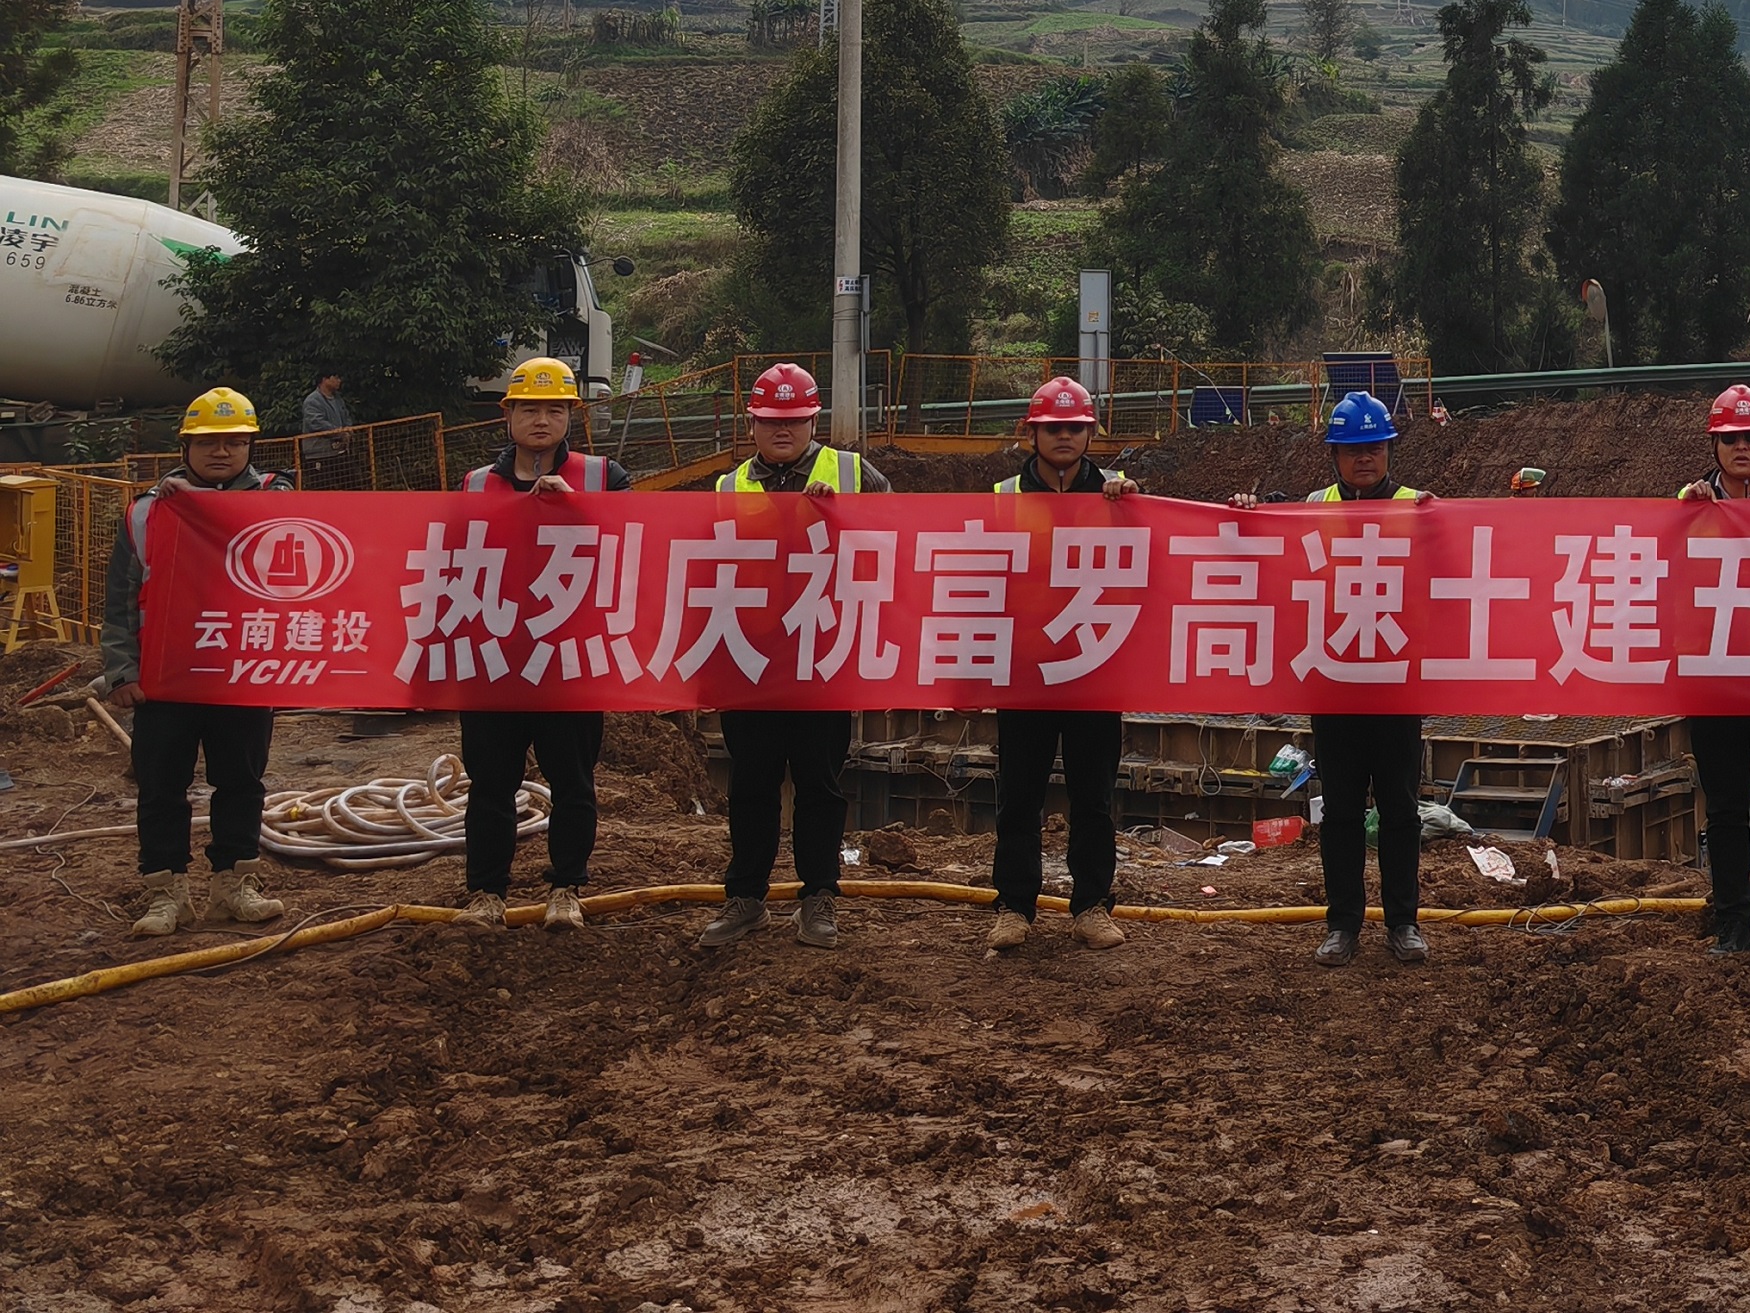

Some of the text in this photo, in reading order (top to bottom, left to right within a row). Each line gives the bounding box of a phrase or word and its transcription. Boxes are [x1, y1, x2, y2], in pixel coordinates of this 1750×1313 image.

[6, 251, 46, 270] 659
[194, 608, 371, 652] 云南建投
[228, 658, 327, 685] YCIH
